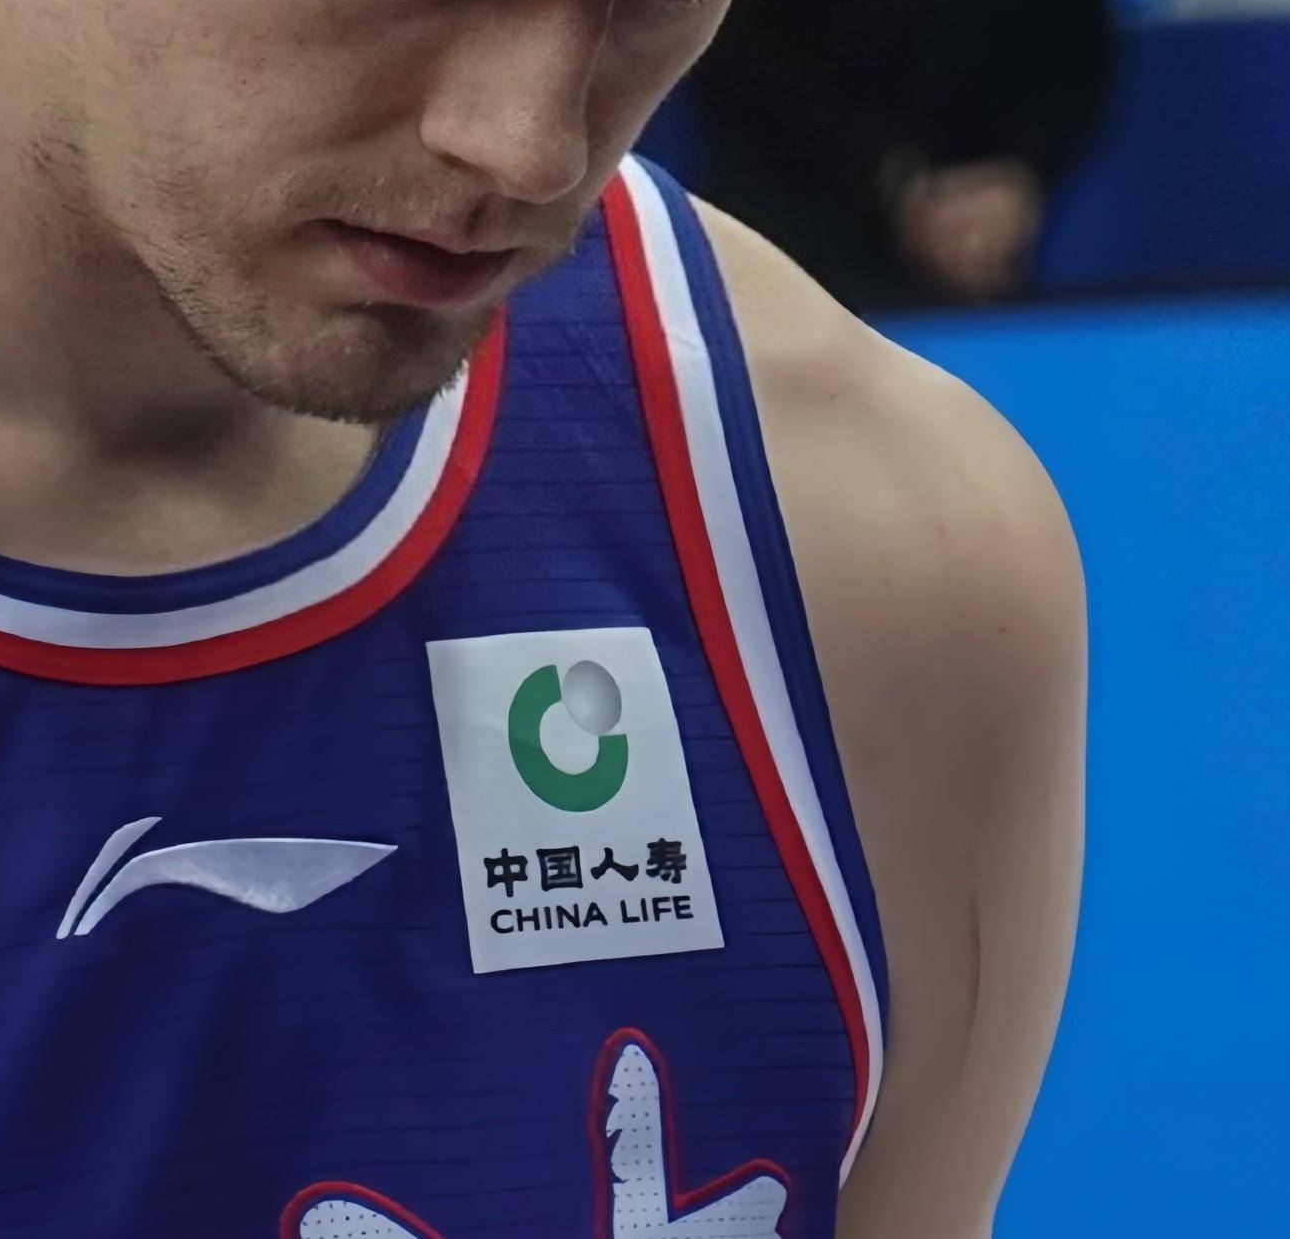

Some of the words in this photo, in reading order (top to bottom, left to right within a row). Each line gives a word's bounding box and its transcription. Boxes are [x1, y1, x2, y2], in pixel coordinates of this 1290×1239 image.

[483, 837, 687, 898] 中国人寿
[490, 901, 608, 934] CHINA
[620, 895, 694, 924] LIFE
